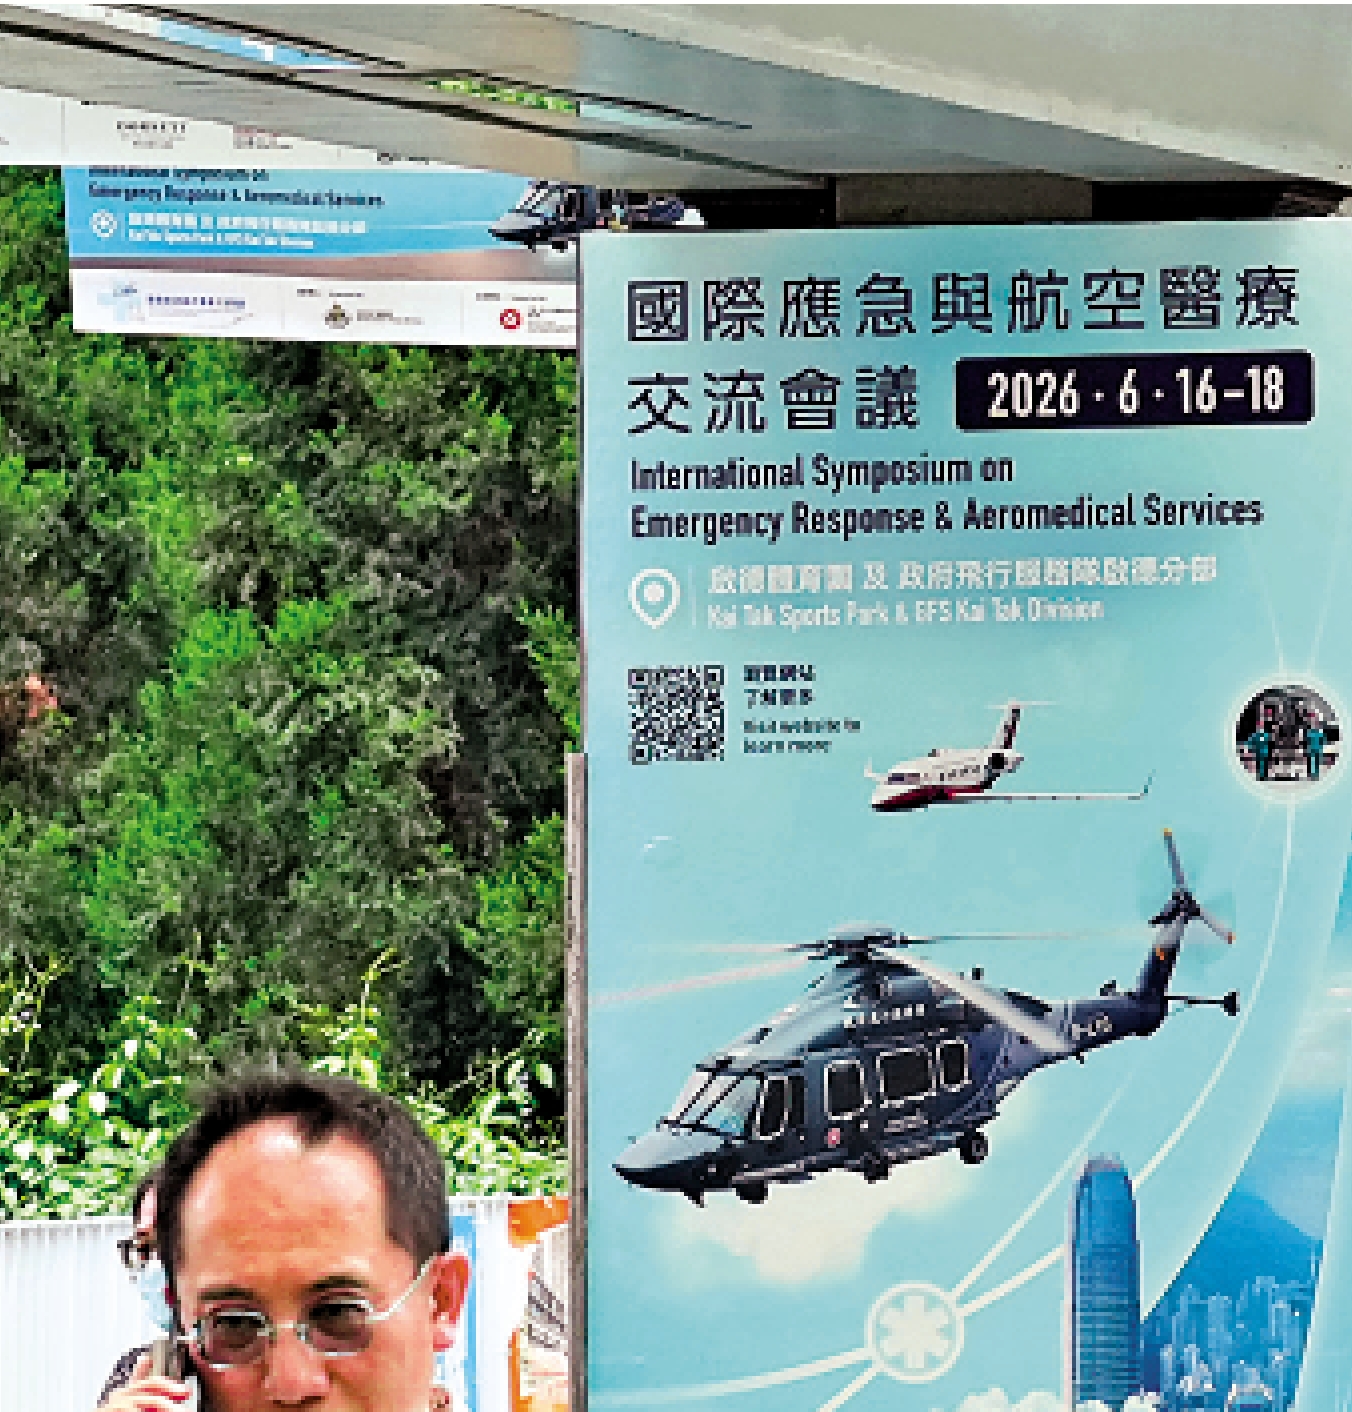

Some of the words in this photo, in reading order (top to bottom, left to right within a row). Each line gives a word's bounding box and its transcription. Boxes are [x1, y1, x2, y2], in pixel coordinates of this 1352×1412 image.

[627, 264, 1300, 343] 國際應急與航空醫療
[627, 365, 920, 435] 交流會議
[631, 454, 804, 494] International
[812, 451, 972, 493] Symposium
[980, 455, 1013, 482] on
[631, 504, 784, 545] Emergency
[792, 500, 925, 540] Response
[934, 502, 952, 532] &
[962, 495, 1136, 532] Aeromedical
[1143, 492, 1264, 527] Services
[863, 560, 888, 590] 及
[708, 604, 737, 629] Kai
[779, 601, 840, 633] Sports
[847, 600, 888, 626] Park
[955, 600, 985, 622] Kai
[1027, 596, 1105, 622] Division
